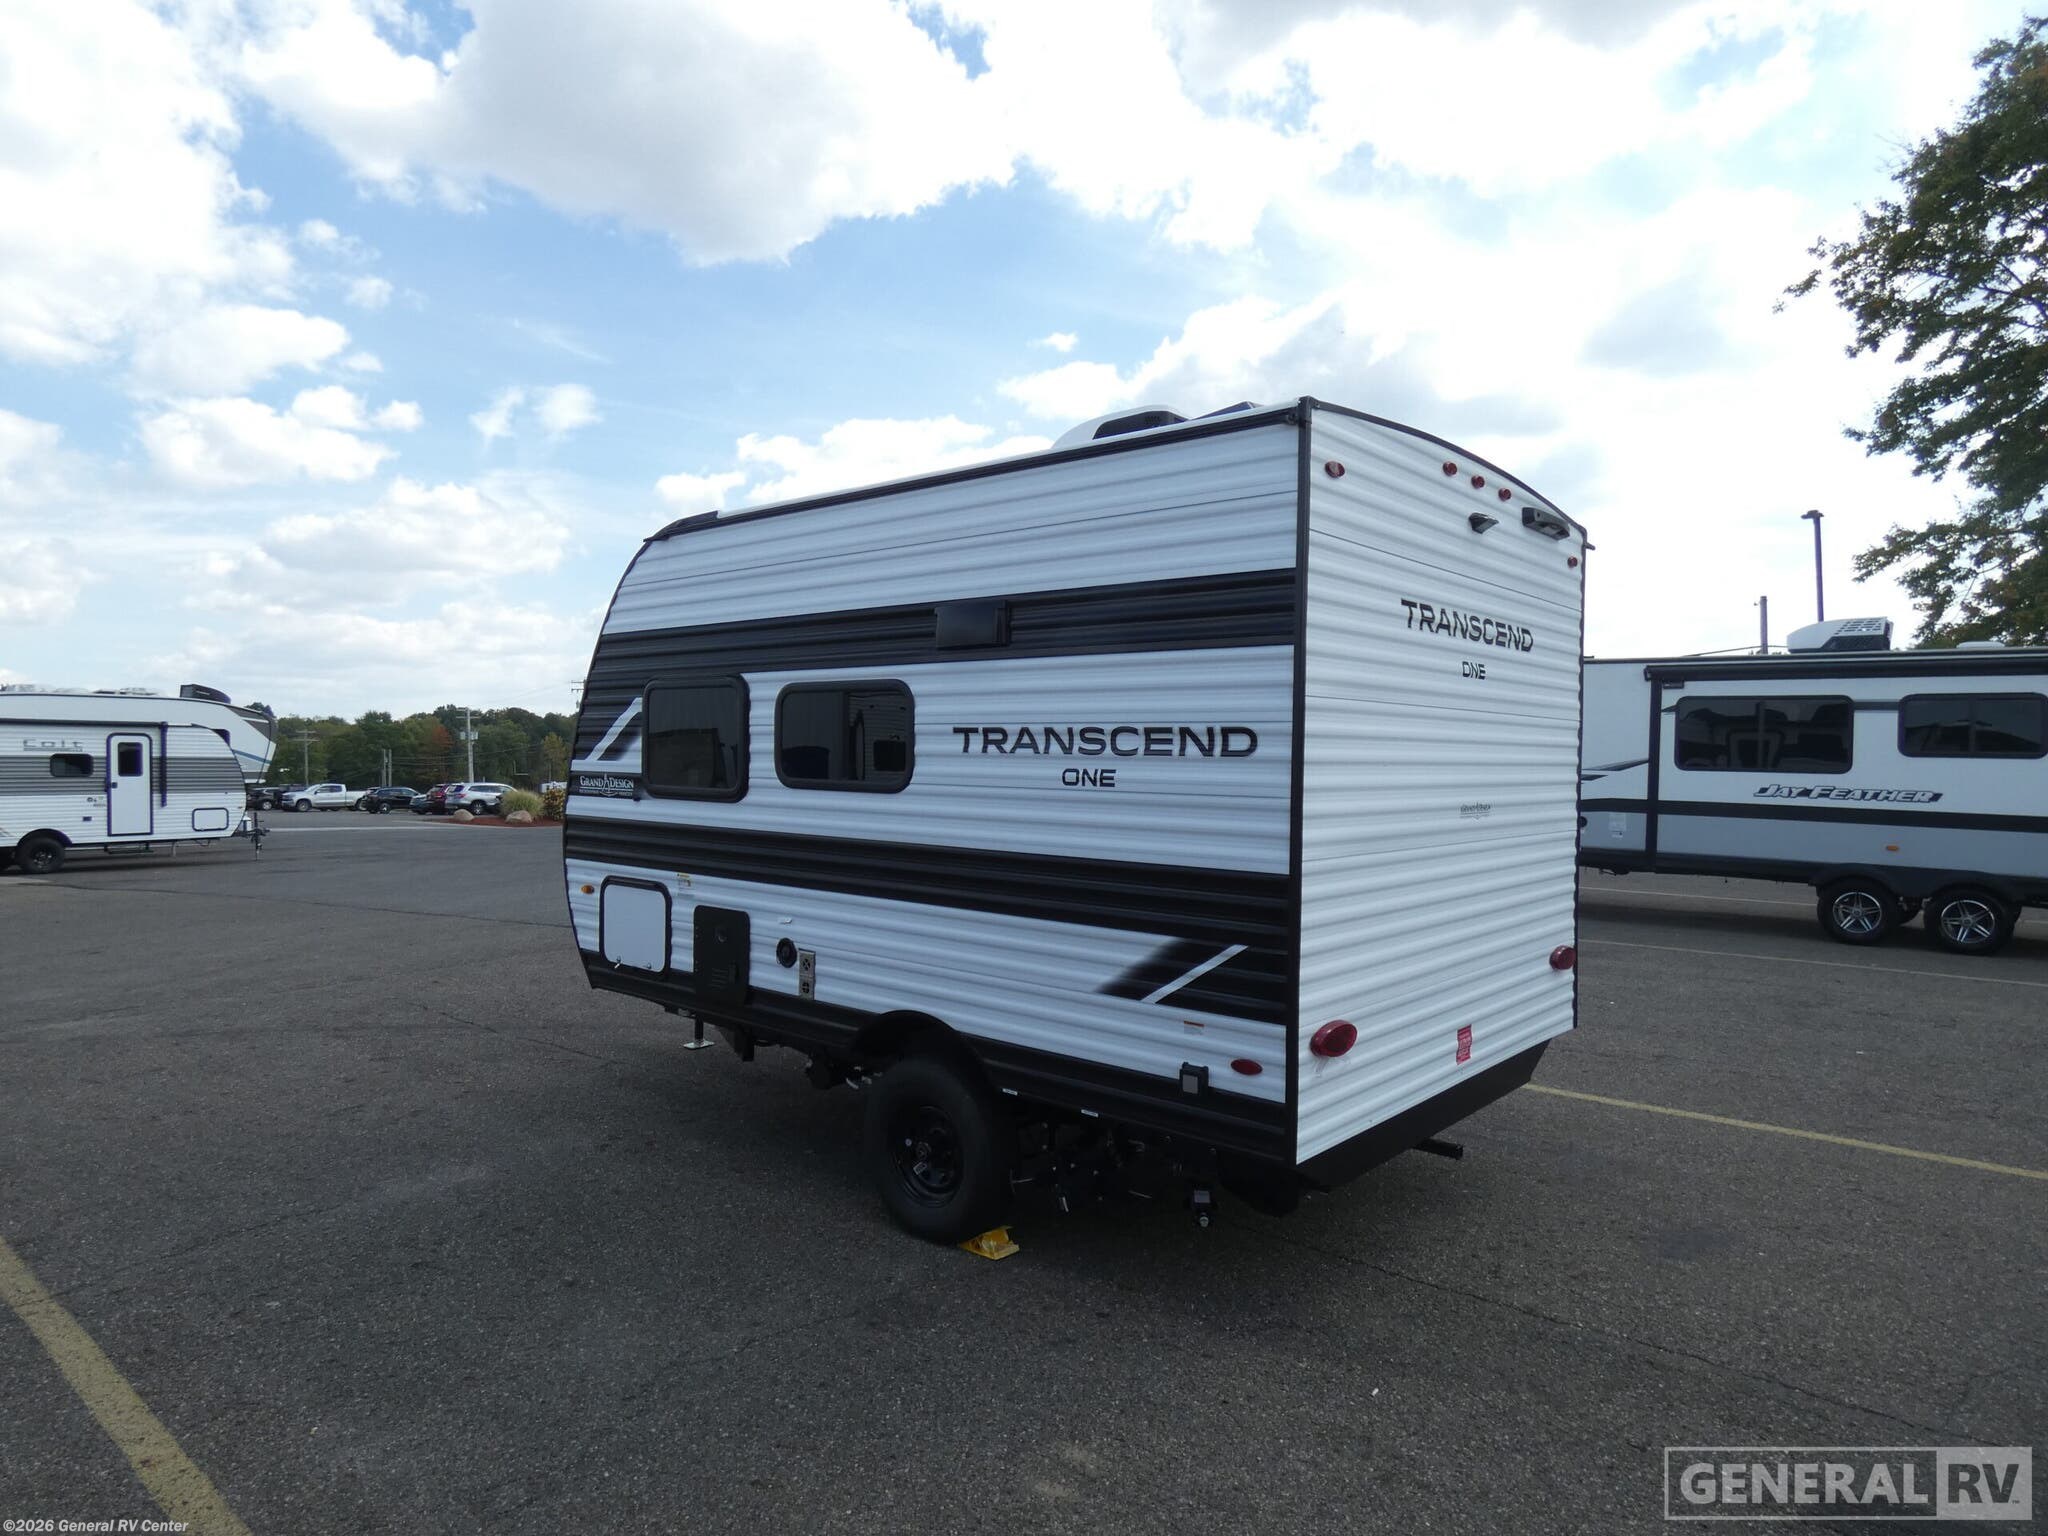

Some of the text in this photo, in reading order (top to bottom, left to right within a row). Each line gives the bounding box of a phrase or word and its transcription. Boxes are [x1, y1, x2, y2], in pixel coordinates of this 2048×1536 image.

[1400, 598, 1534, 653] TRANSCEND
[1461, 661, 1486, 680] ONE
[23, 739, 83, 748] Colt
[952, 726, 1258, 757] TRANSCEND
[579, 775, 635, 789] GRAND DESIGN
[1062, 768, 1117, 788] ONE
[1753, 784, 1936, 803] JAY FEATHER
